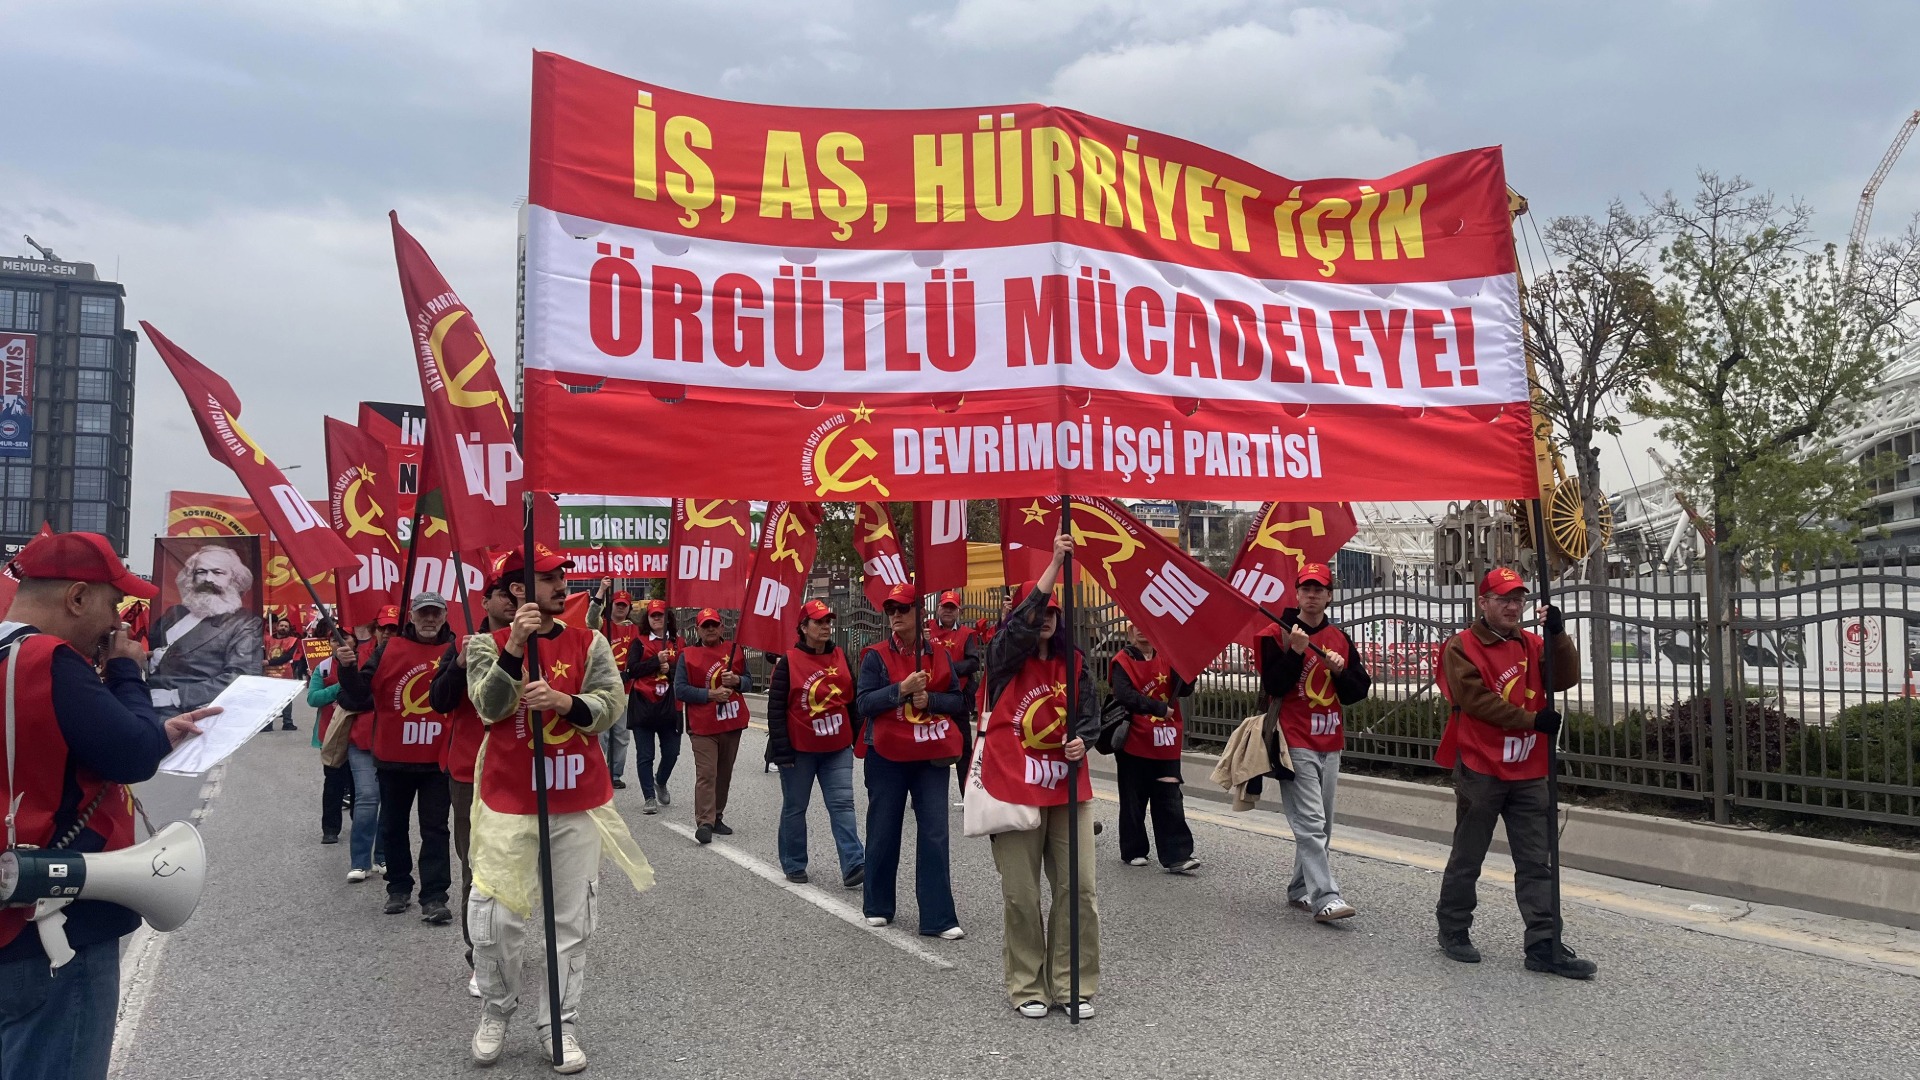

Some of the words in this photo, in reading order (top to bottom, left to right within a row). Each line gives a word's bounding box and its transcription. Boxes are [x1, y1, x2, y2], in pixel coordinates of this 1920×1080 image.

[633, 90, 736, 228] İŞ,
[758, 129, 888, 242] AŞ,
[913, 112, 1261, 253] HÜRRİYET
[1273, 183, 1428, 278] İÇİN
[2, 260, 77, 276] MEMUR-SEN
[589, 241, 976, 373] ÖRGÜTLÜ
[1004, 266, 1479, 389] MÜCADELEYE!
[5, 345, 24, 396] MAYIS
[816, 412, 846, 435] PARTİSİ
[806, 430, 821, 450] İŞÇİ
[892, 414, 1092, 475] DEVRİMCİ
[1102, 416, 1175, 484] İŞÇİ
[1184, 426, 1322, 479] PARTİSİ
[800, 443, 814, 487] DEVRİMCİ
[608, 551, 640, 575] İŞÇİ
[678, 540, 734, 581] DİP
[402, 717, 442, 745] DİP
[812, 712, 843, 737] DİP
[913, 719, 950, 743] DİP
[1153, 723, 1177, 747] DİP
[1310, 708, 1341, 736] DİP
[1502, 731, 1537, 763] DİP
[1024, 754, 1069, 790] DİP
